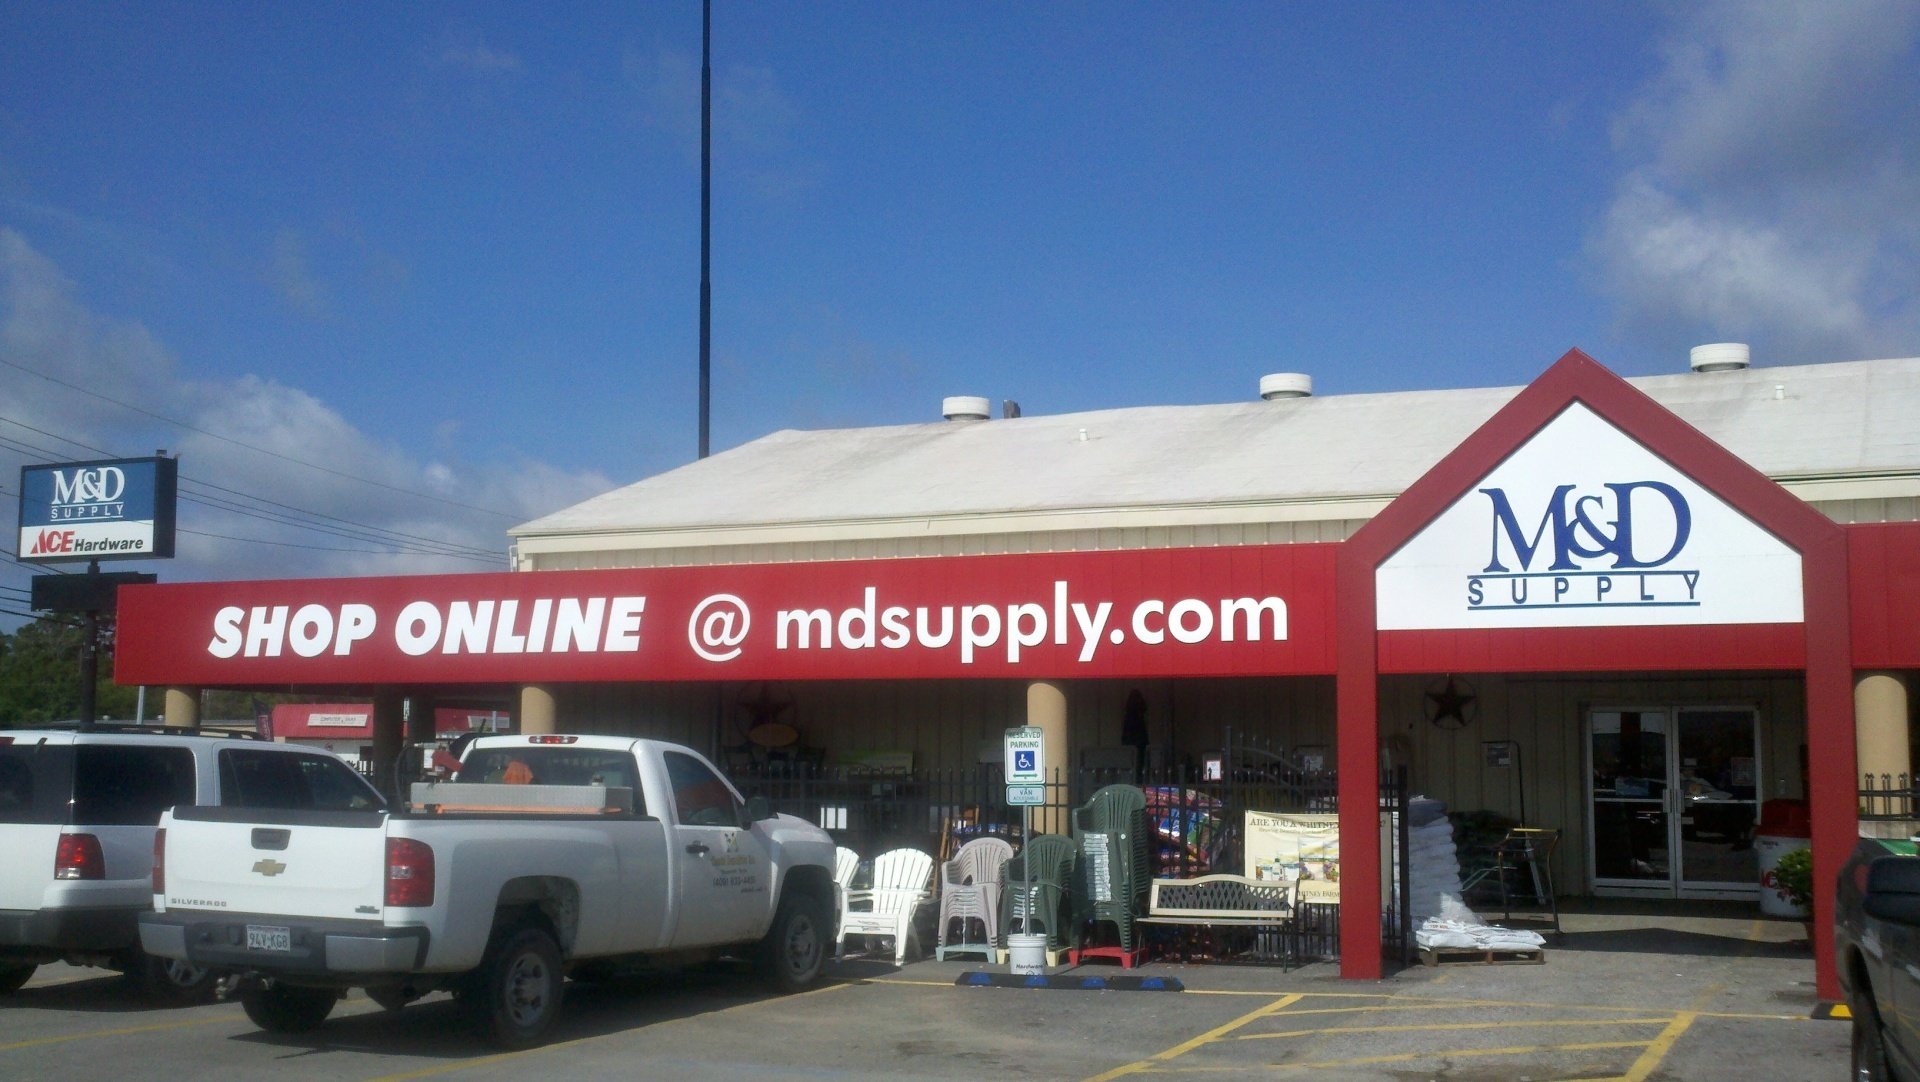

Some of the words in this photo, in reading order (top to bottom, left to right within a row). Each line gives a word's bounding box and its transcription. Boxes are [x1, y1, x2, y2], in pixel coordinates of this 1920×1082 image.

[51, 466, 125, 504] M&D
[51, 504, 124, 519] SUPPLY
[1478, 480, 1692, 573] M&D
[30, 528, 75, 555] ACE
[74, 537, 144, 552] Hardware
[1467, 573, 1700, 606] SUPPLY
[207, 604, 377, 659] SHOP
[395, 596, 647, 656] ONLINE
[776, 580, 1288, 664] mdsupply.com
[1249, 818, 1270, 826] ARE
[1272, 819, 1289, 827] YOU
[1289, 820, 1297, 828] A
[171, 898, 227, 907] SILVERADO
